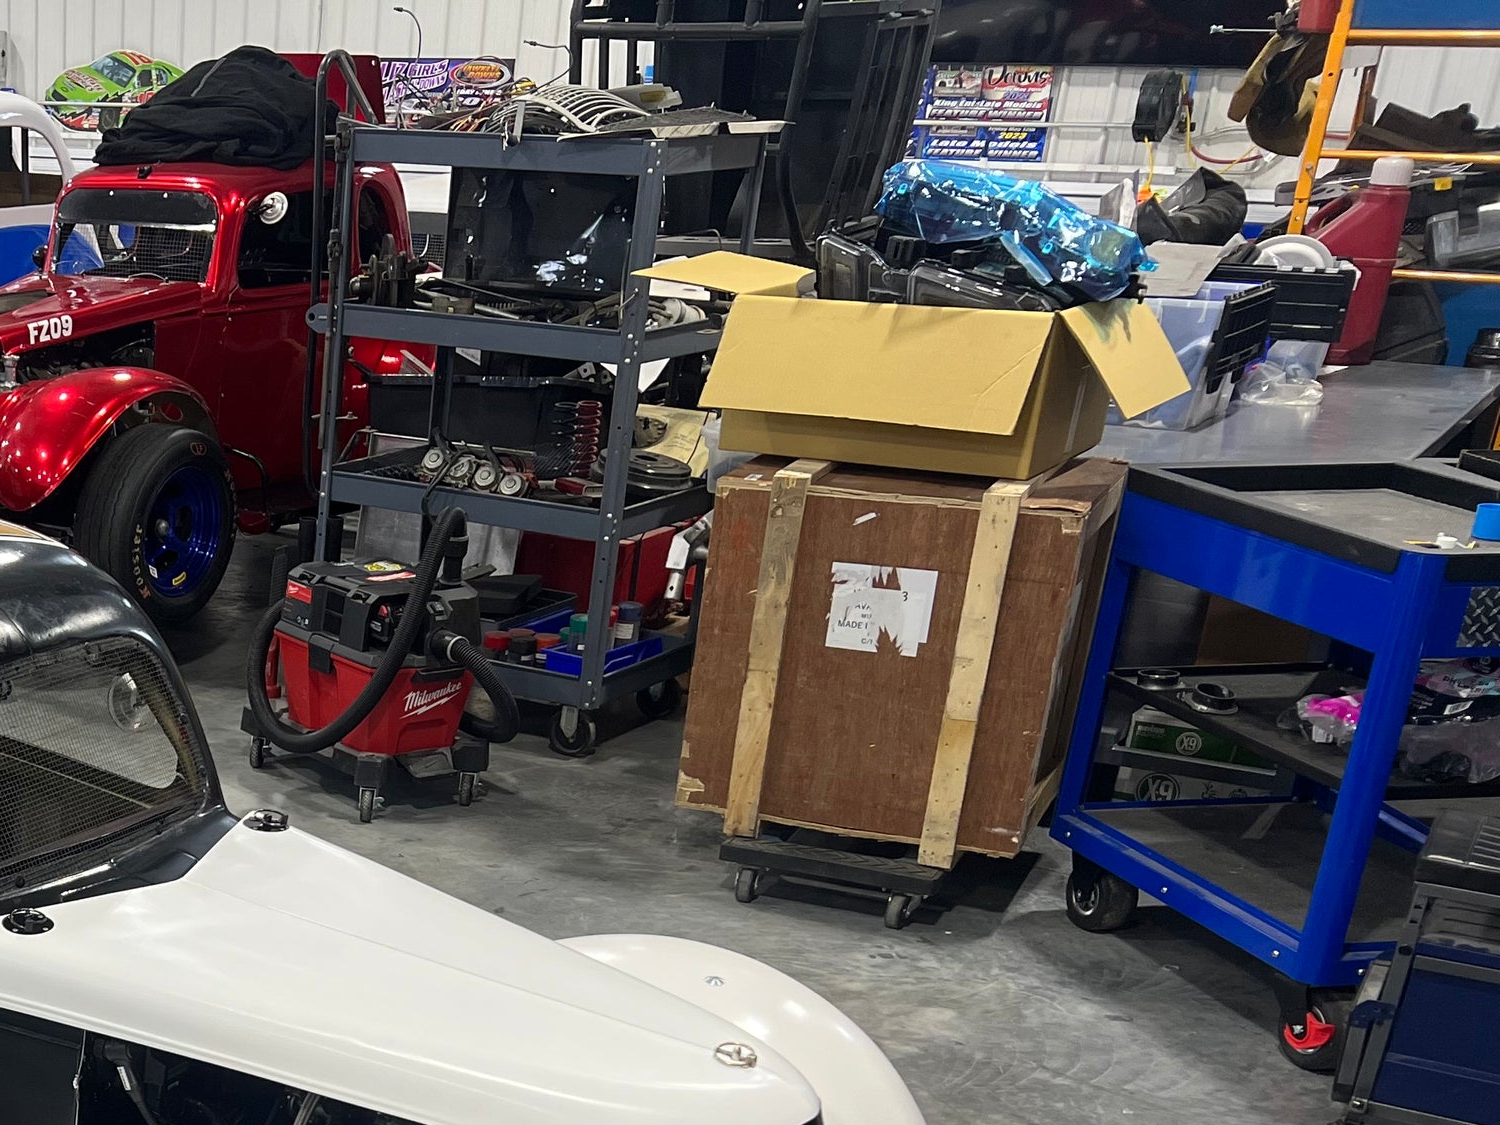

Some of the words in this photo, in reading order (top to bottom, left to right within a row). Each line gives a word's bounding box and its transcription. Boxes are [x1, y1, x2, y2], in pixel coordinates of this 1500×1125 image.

[929, 108, 987, 119] FEATURE
[988, 109, 1044, 120] WINNER
[930, 139, 969, 148] Late
[926, 148, 983, 158] FEATURE
[27, 314, 73, 345] FZ09
[837, 619, 863, 630] MADE
[403, 681, 462, 712] Milwaukee
